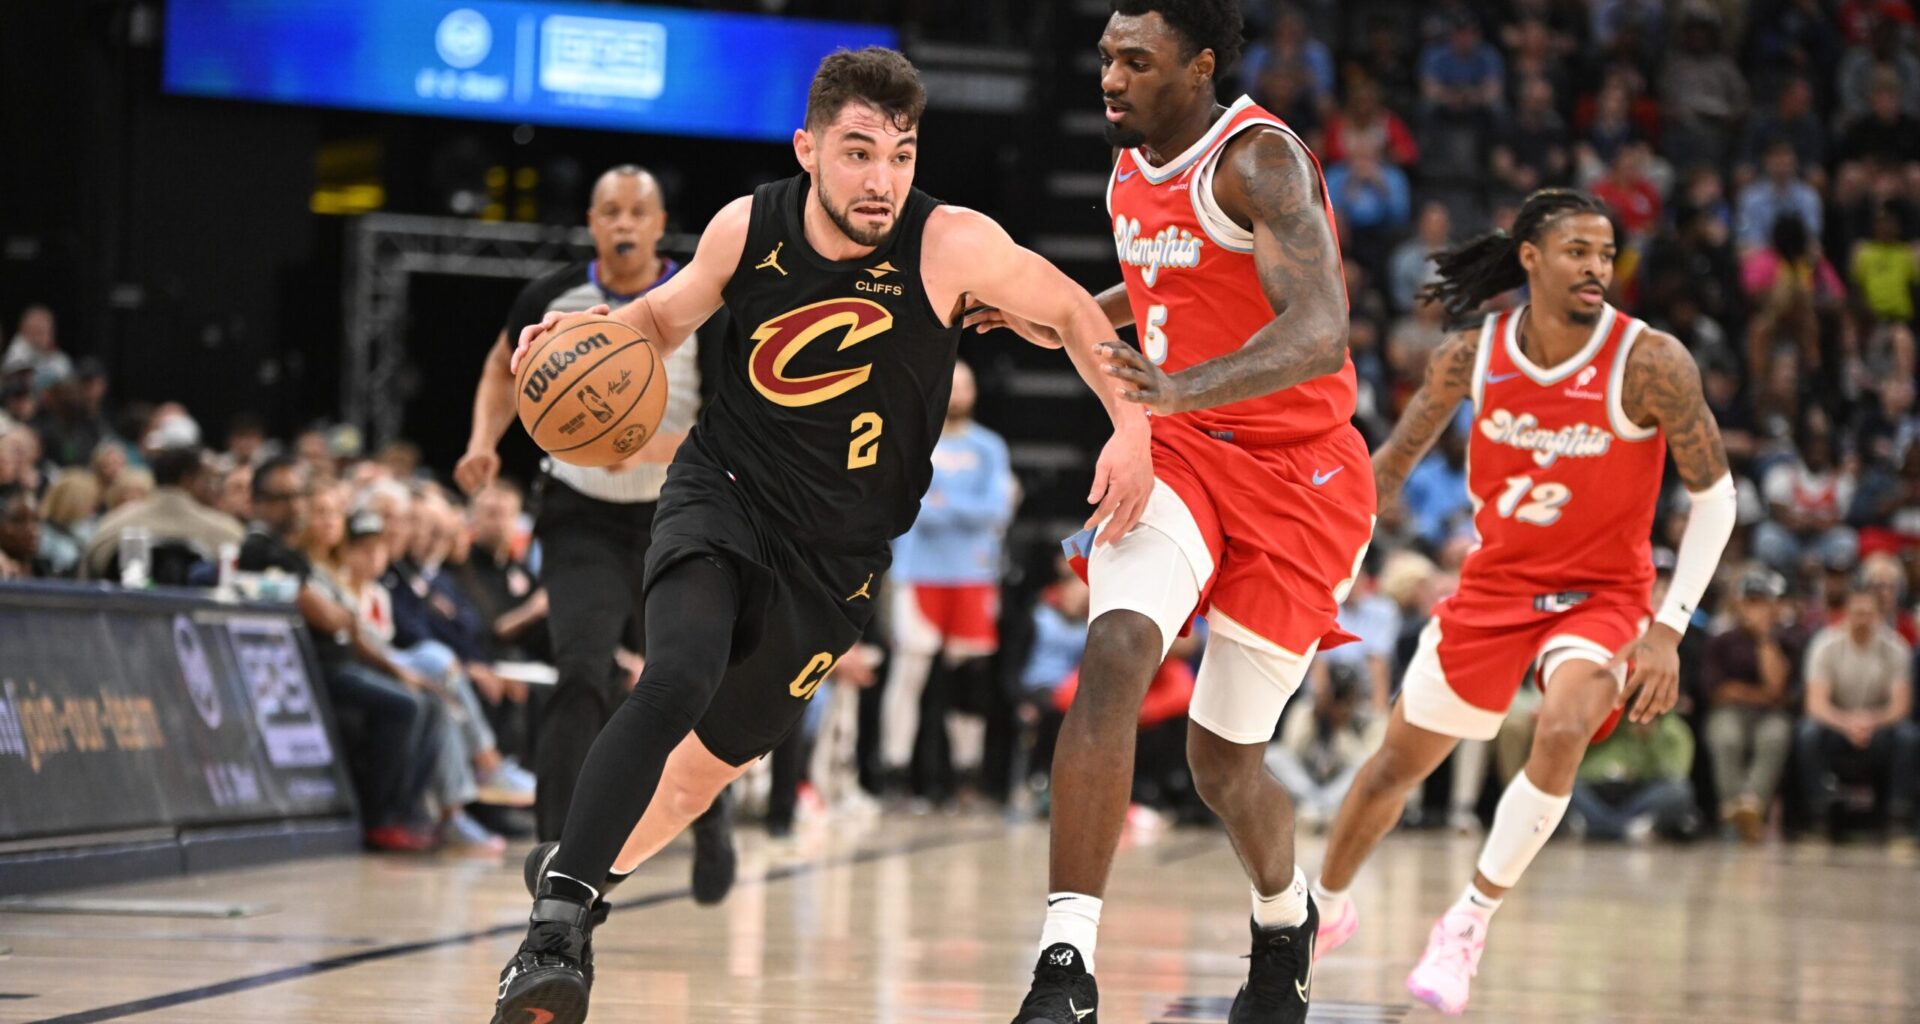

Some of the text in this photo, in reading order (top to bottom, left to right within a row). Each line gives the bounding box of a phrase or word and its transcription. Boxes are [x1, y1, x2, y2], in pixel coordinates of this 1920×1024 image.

[1114, 213, 1202, 287] Memphis
[855, 280, 903, 296] CLIFFS
[748, 297, 894, 408] C
[1144, 303, 1168, 366] 5
[523, 332, 612, 403] Wilson
[847, 411, 884, 470] 2
[1480, 408, 1612, 467] Memphis
[1497, 474, 1572, 528] 12
[789, 651, 838, 700] C
